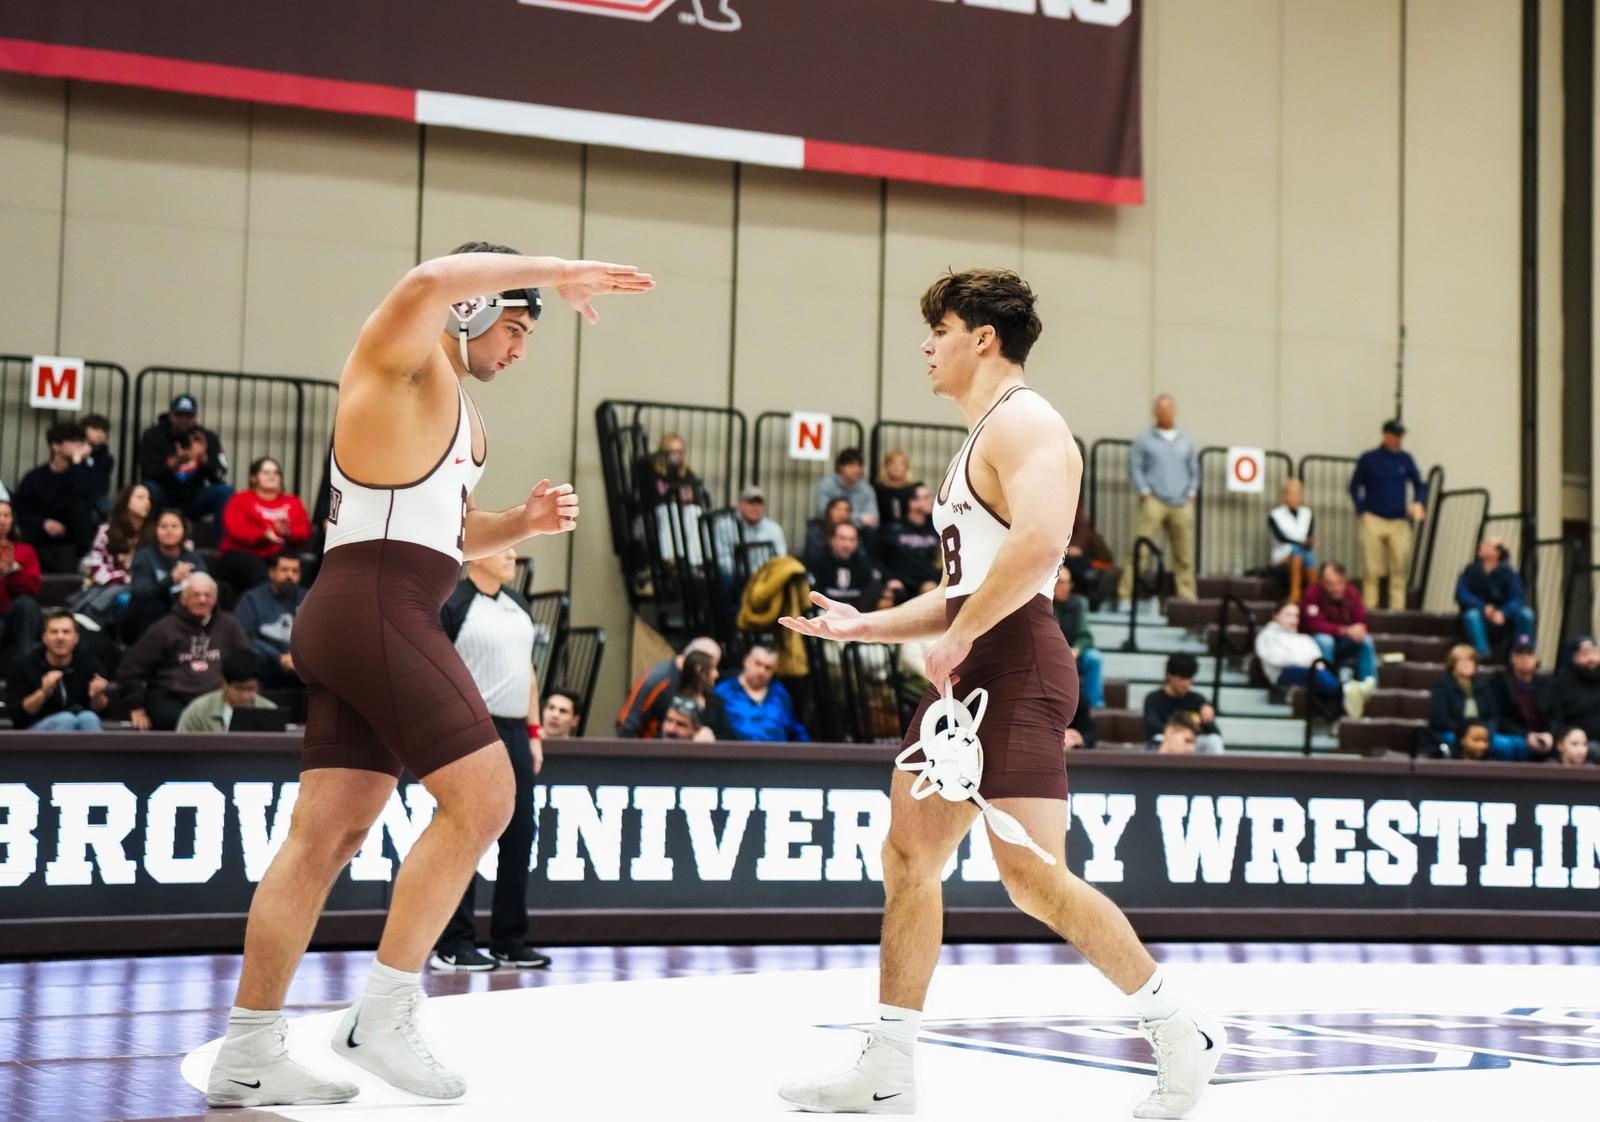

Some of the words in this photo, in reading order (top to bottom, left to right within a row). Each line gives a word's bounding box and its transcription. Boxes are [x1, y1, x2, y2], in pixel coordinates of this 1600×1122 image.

[37, 366, 77, 400] M
[798, 421, 823, 450] N
[1234, 455, 1257, 483] O
[476, 785, 1136, 883] NIVERIY
